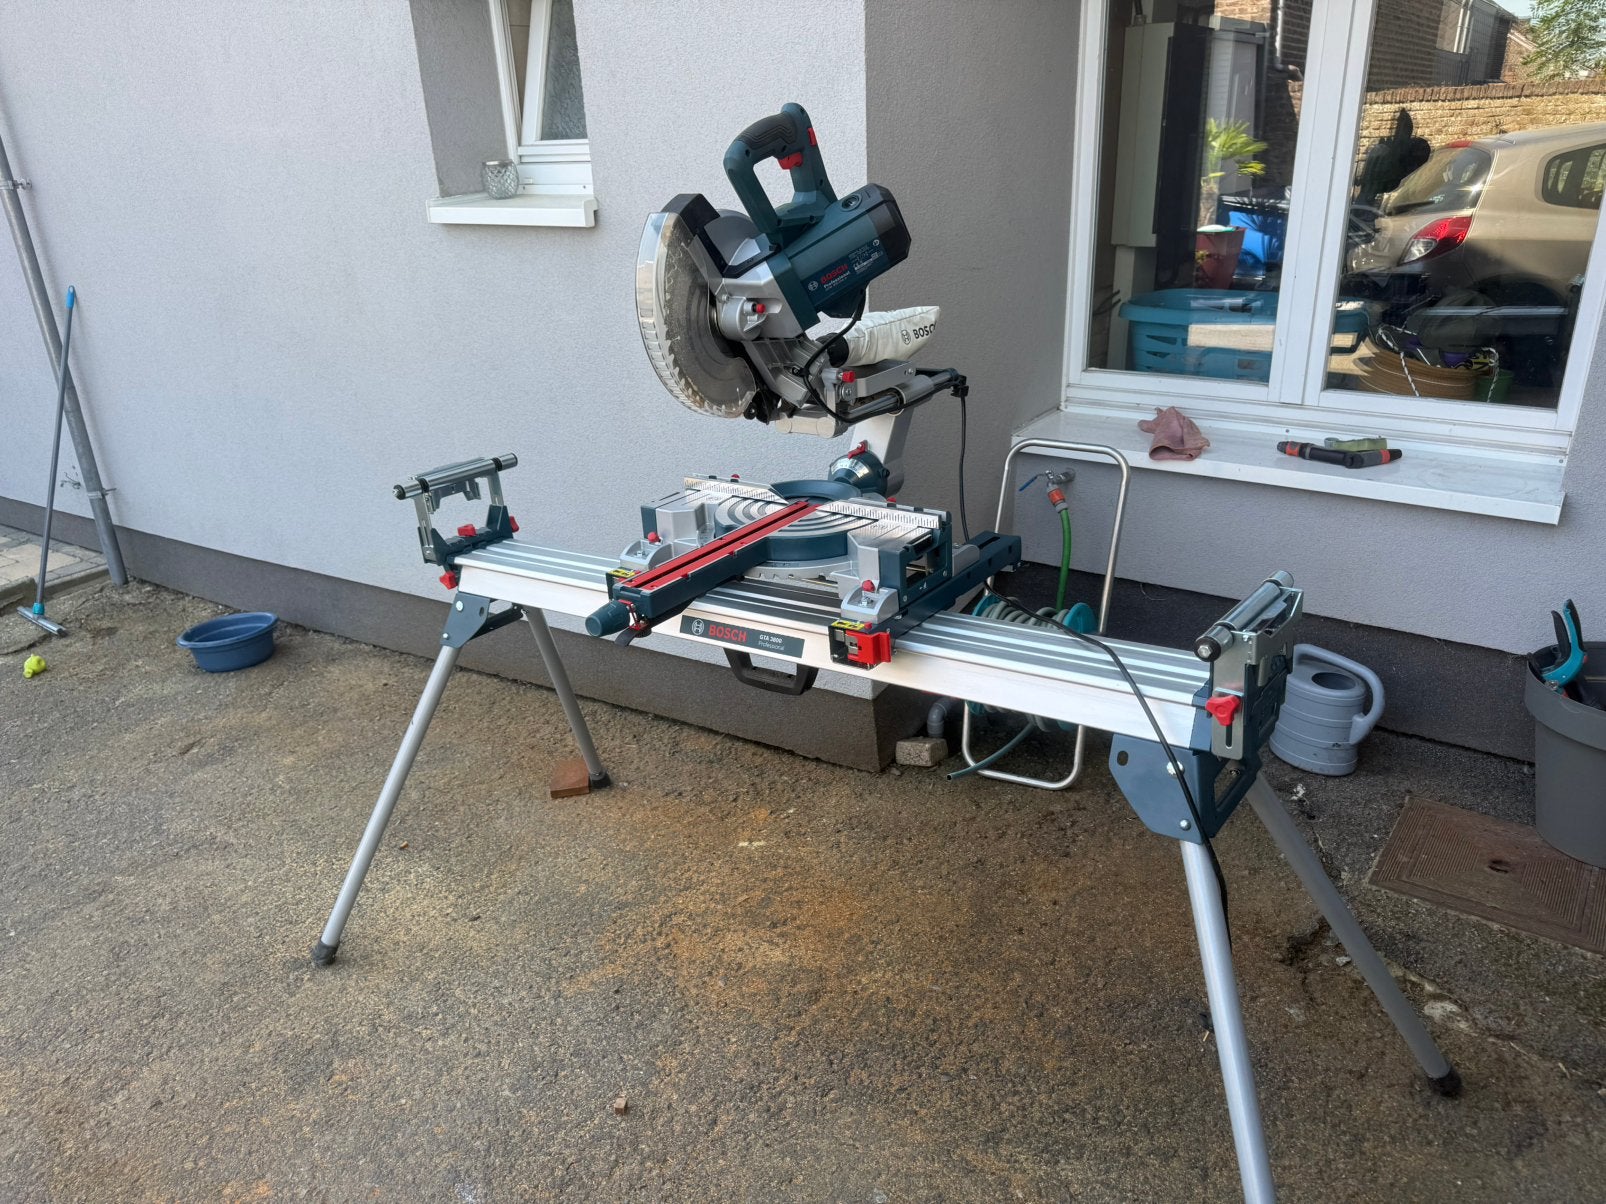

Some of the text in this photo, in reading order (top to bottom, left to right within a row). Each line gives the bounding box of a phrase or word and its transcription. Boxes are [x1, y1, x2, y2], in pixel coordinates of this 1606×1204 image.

[820, 263, 849, 284] BOSCH
[823, 270, 851, 288] Professional
[912, 322, 936, 340] BOSC
[708, 624, 747, 643] BOSCH
[759, 634, 770, 642] GTA
[758, 640, 785, 651] Professional
